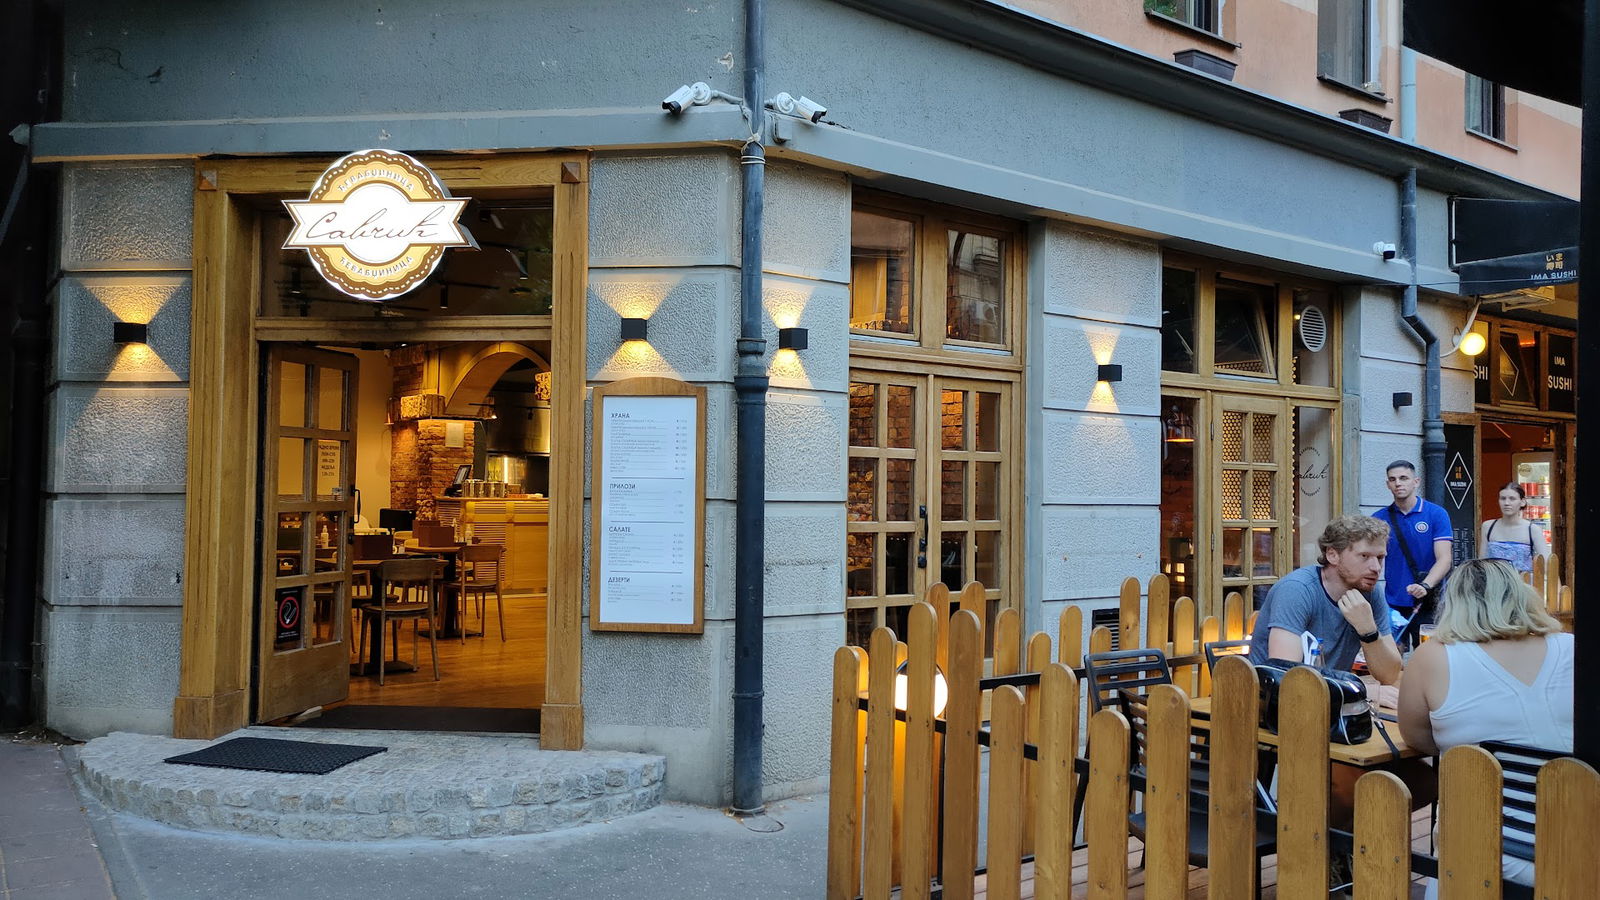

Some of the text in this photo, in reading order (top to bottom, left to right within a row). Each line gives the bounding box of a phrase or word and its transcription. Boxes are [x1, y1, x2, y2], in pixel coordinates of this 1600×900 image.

[339, 255, 413, 278] ЋЕВАБЏИНИЦА
[1550, 270, 1577, 279] SUSHI
[1554, 356, 1565, 366] IMA
[1547, 375, 1572, 391] SUSHI
